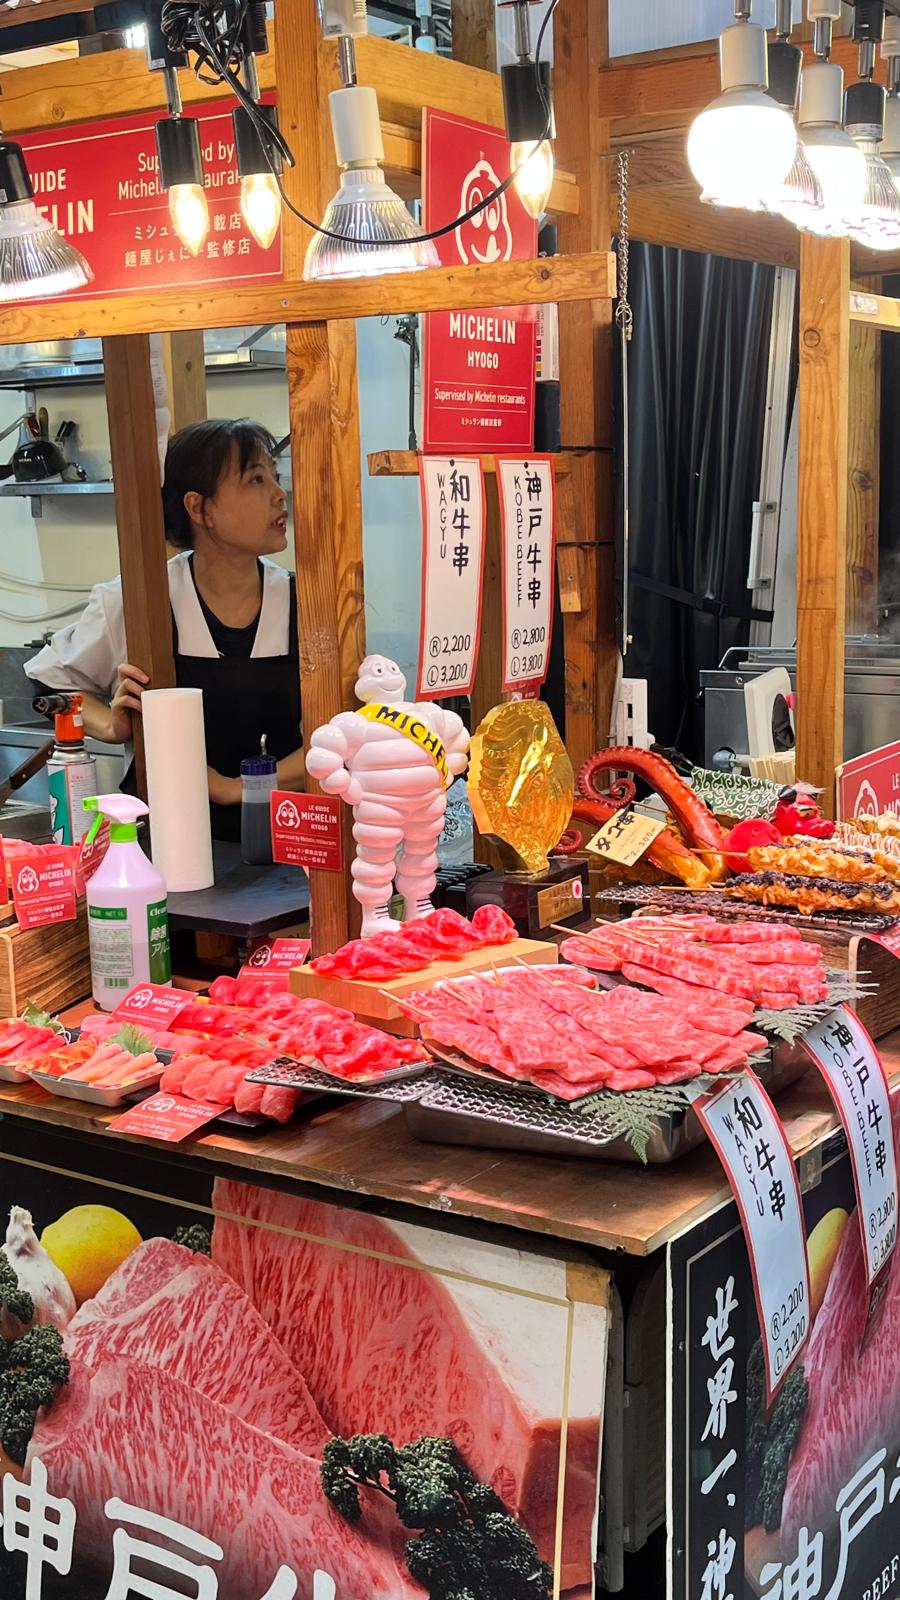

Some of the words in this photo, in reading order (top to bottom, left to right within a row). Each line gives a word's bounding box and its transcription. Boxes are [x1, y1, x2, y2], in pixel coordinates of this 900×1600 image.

[218, 141, 235, 164] by
[28, 168, 67, 194] UIDE
[449, 312, 516, 345] MICHELIN
[467, 350, 499, 370] HYOGO
[434, 387, 466, 403] Supervised
[467, 390, 474, 404] by
[474, 389, 497, 403] Michelin
[497, 394, 526, 405] restaurants
[437, 472, 447, 560] WAGYU
[449, 469, 471, 577] 和牛串
[513, 475, 524, 540] KOBE
[524, 471, 543, 610] 神戸牛串
[516, 543, 524, 609] BEEF
[442, 634, 471, 656] 2,200
[522, 626, 546, 646] 2,800
[440, 663, 468, 682] 3,200
[521, 653, 543, 673] 3,800
[301, 811, 337, 824] MICHELIN
[40, 868, 71, 881] MICHELIN
[272, 952, 304, 960] MICHELIN
[819, 1035, 858, 1106] KOBE
[857, 1110, 873, 1187] BEEF
[827, 1020, 886, 1178] 神戸牛串
[722, 1113, 764, 1217] WAGYU
[733, 1095, 786, 1222] 和牛串
[781, 1281, 804, 1326] 2,200
[784, 1315, 806, 1359] 3,200
[0, 1457, 337, 1600] 神戸
[760, 1448, 900, 1600] 神戸
